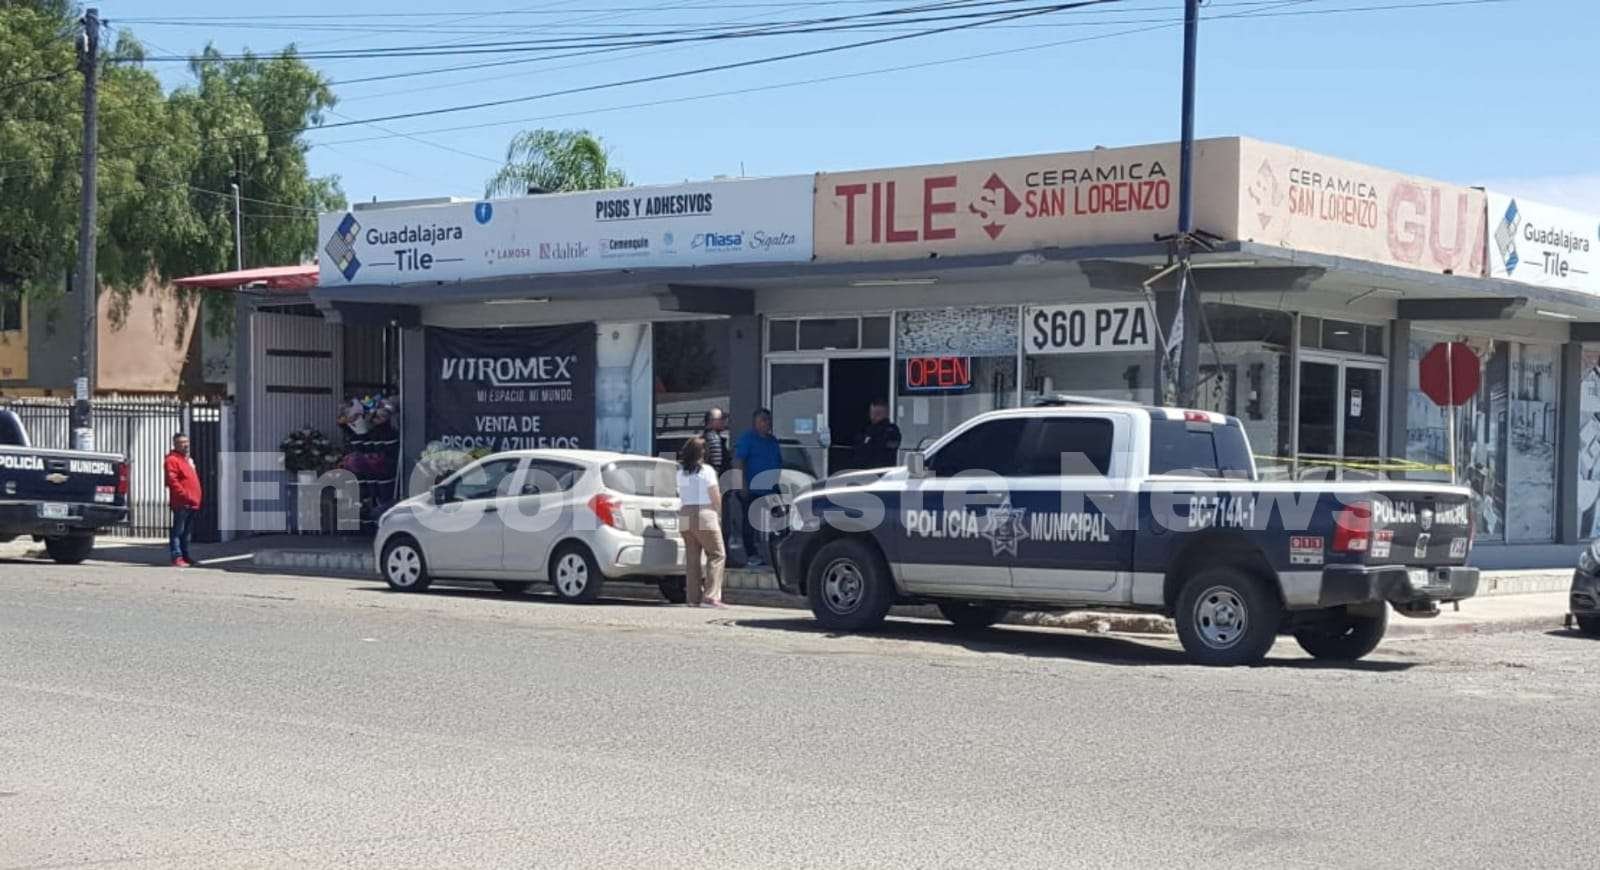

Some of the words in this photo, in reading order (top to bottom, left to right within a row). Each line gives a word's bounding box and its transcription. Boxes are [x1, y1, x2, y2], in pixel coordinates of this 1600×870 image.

[1025, 161, 1167, 188] CERAMICA
[1289, 167, 1378, 199] CERAMICA
[596, 200, 630, 219] PISOS
[634, 199, 642, 216] Y
[645, 193, 713, 216] ADHESIVOS
[835, 176, 957, 245] TILE
[1025, 190, 1065, 218] SAN
[1074, 180, 1170, 215] LORENZO
[1288, 185, 1316, 217] SAN
[1320, 193, 1378, 230] LORENZO
[366, 224, 463, 246] Guadalajara
[1524, 222, 1590, 254] Guadalajara
[395, 248, 434, 271] Tile
[497, 248, 531, 260] LAMOSA
[552, 242, 588, 260] daltile
[1543, 250, 1569, 278] Tile
[1033, 308, 1086, 350] $60
[1095, 306, 1148, 346] PZA
[442, 355, 572, 386] VITROMEX
[908, 357, 969, 387] OPEN
[475, 416, 517, 432] VENTA
[522, 416, 540, 432] DE
[441, 435, 484, 449] PISOS
[70, 460, 114, 475] MUNICIPAL
[906, 509, 979, 538] POLICÍA
[1031, 512, 1109, 542] MUNICIPAL
[1188, 497, 1255, 528] BC-714A-1
[1291, 538, 1322, 549] 911
